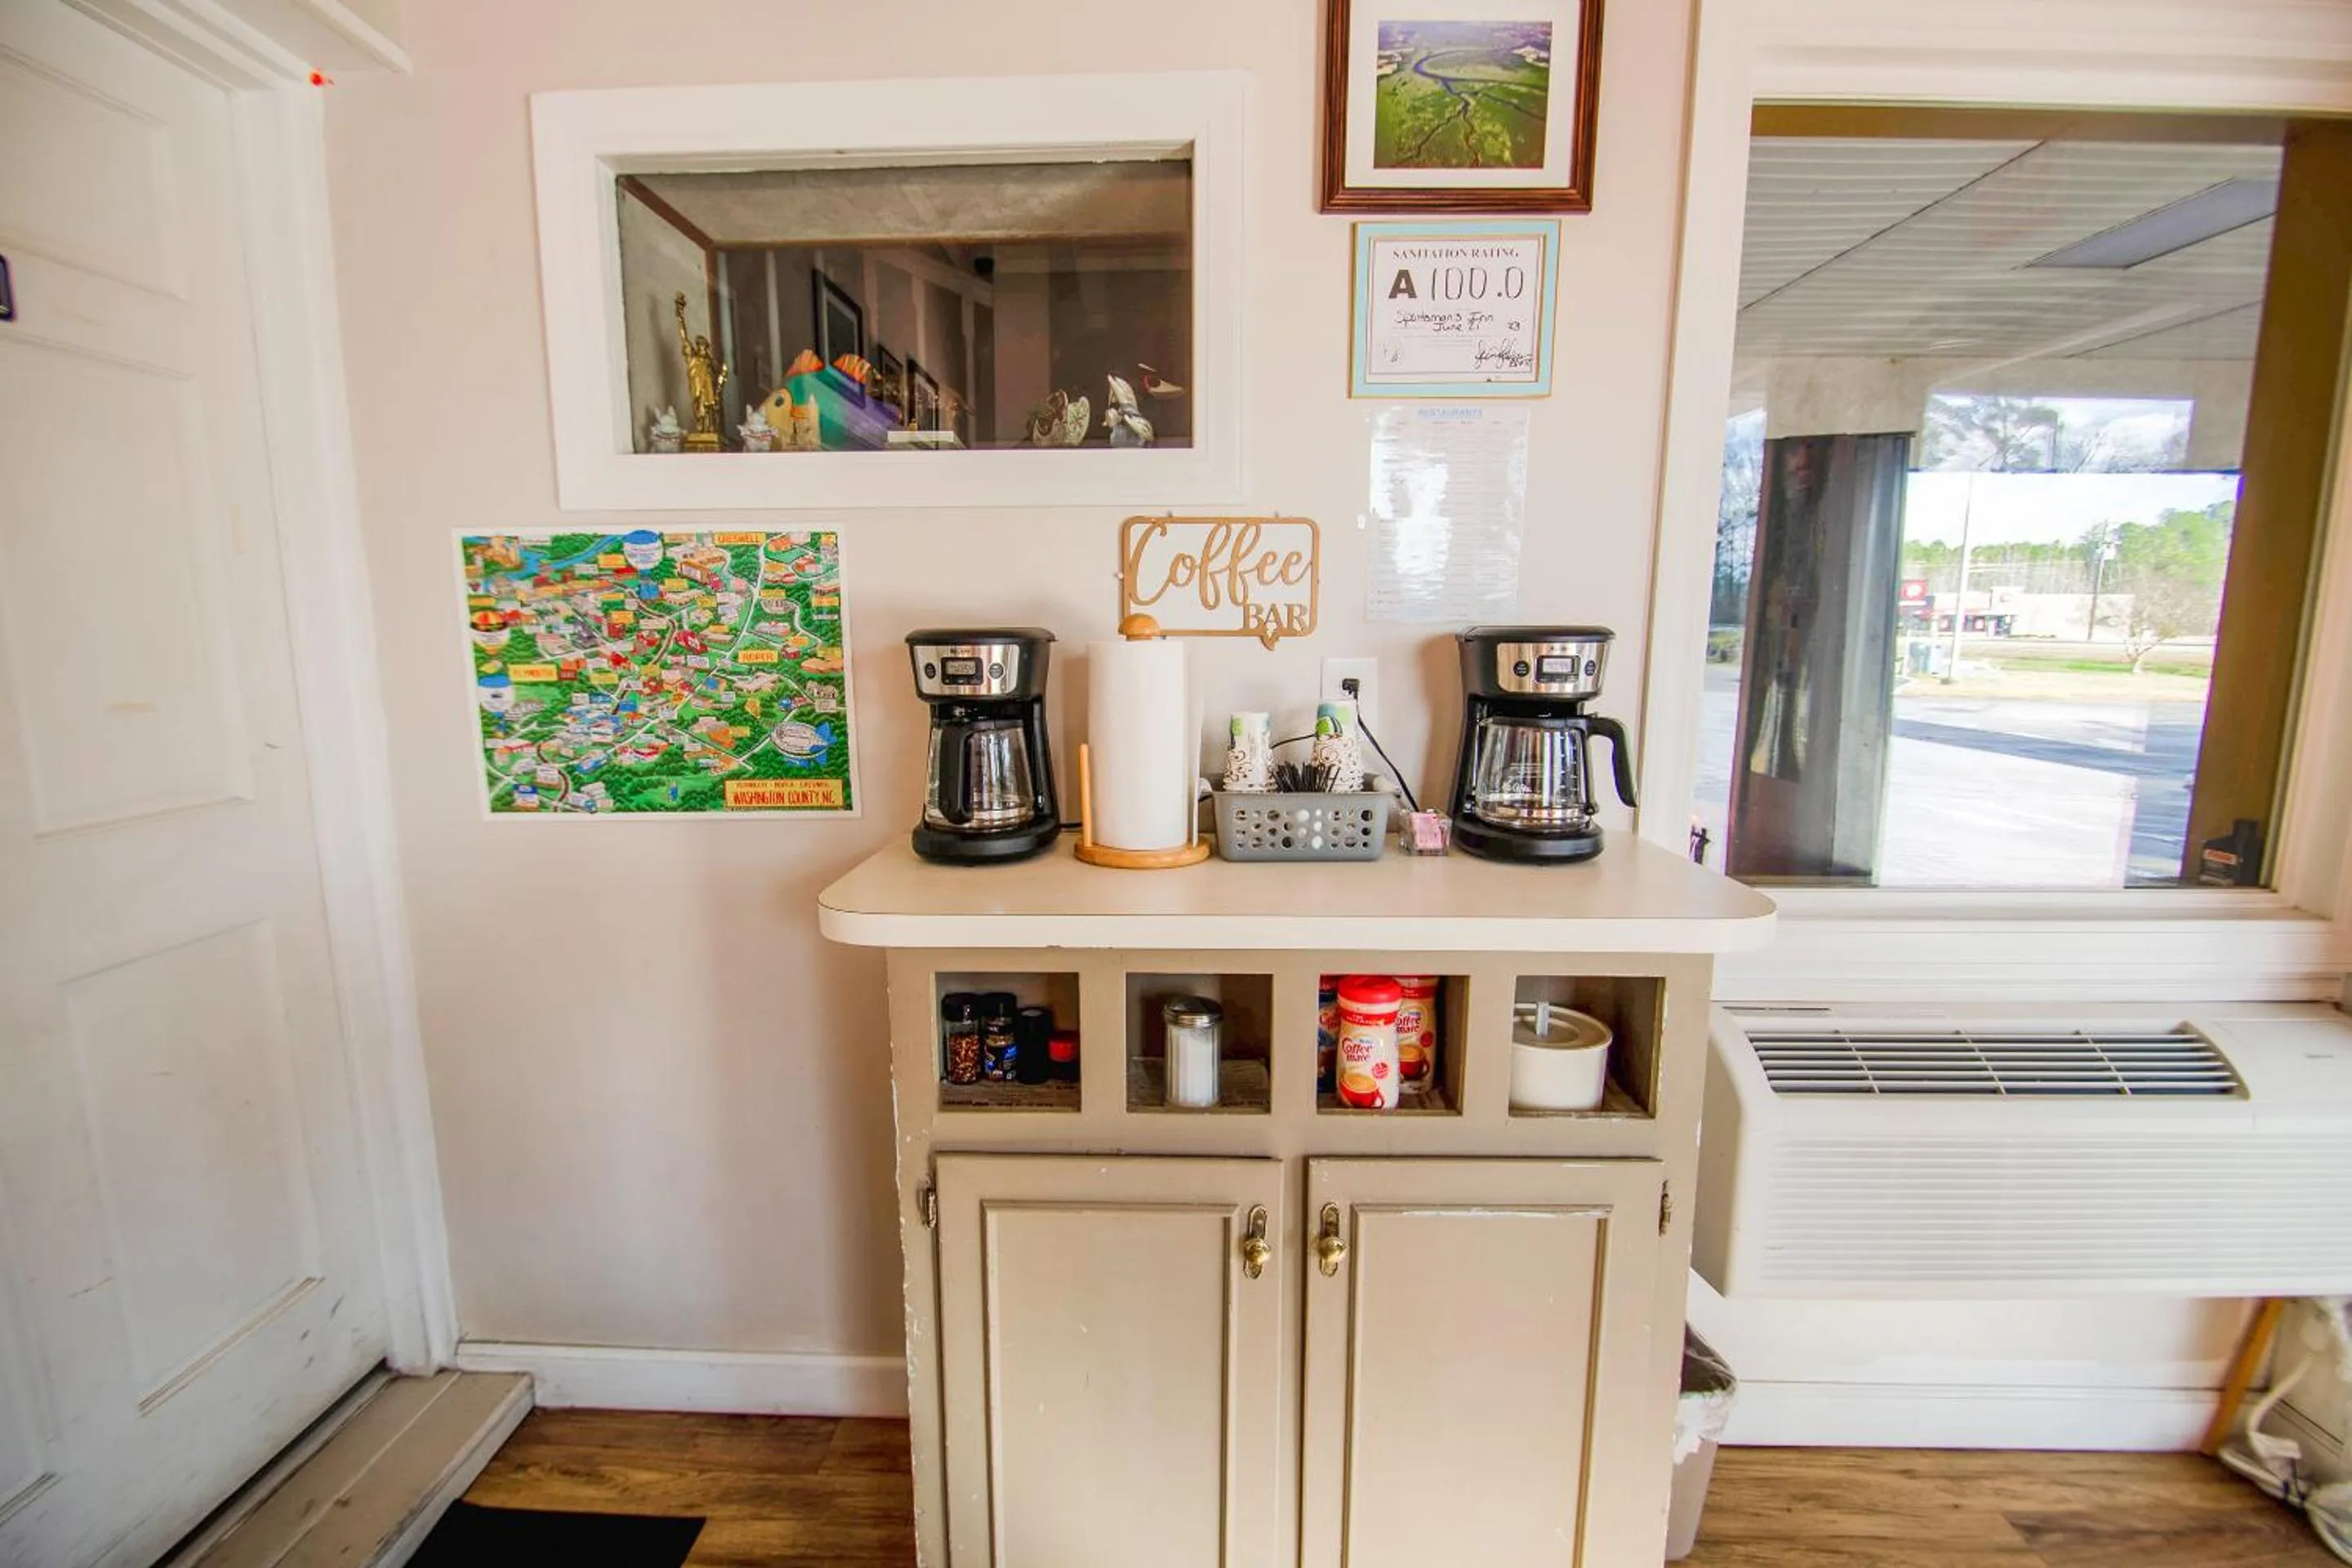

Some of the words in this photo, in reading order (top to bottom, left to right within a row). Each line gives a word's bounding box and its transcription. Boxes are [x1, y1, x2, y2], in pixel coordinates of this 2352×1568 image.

[1393, 248, 1467, 259] SANITATION
[1469, 248, 1519, 259] RATING
[1388, 269, 1418, 300] A
[1431, 266, 1524, 301] 100.0
[1129, 522, 1312, 611] Coffee
[1242, 603, 1308, 630] BAR
